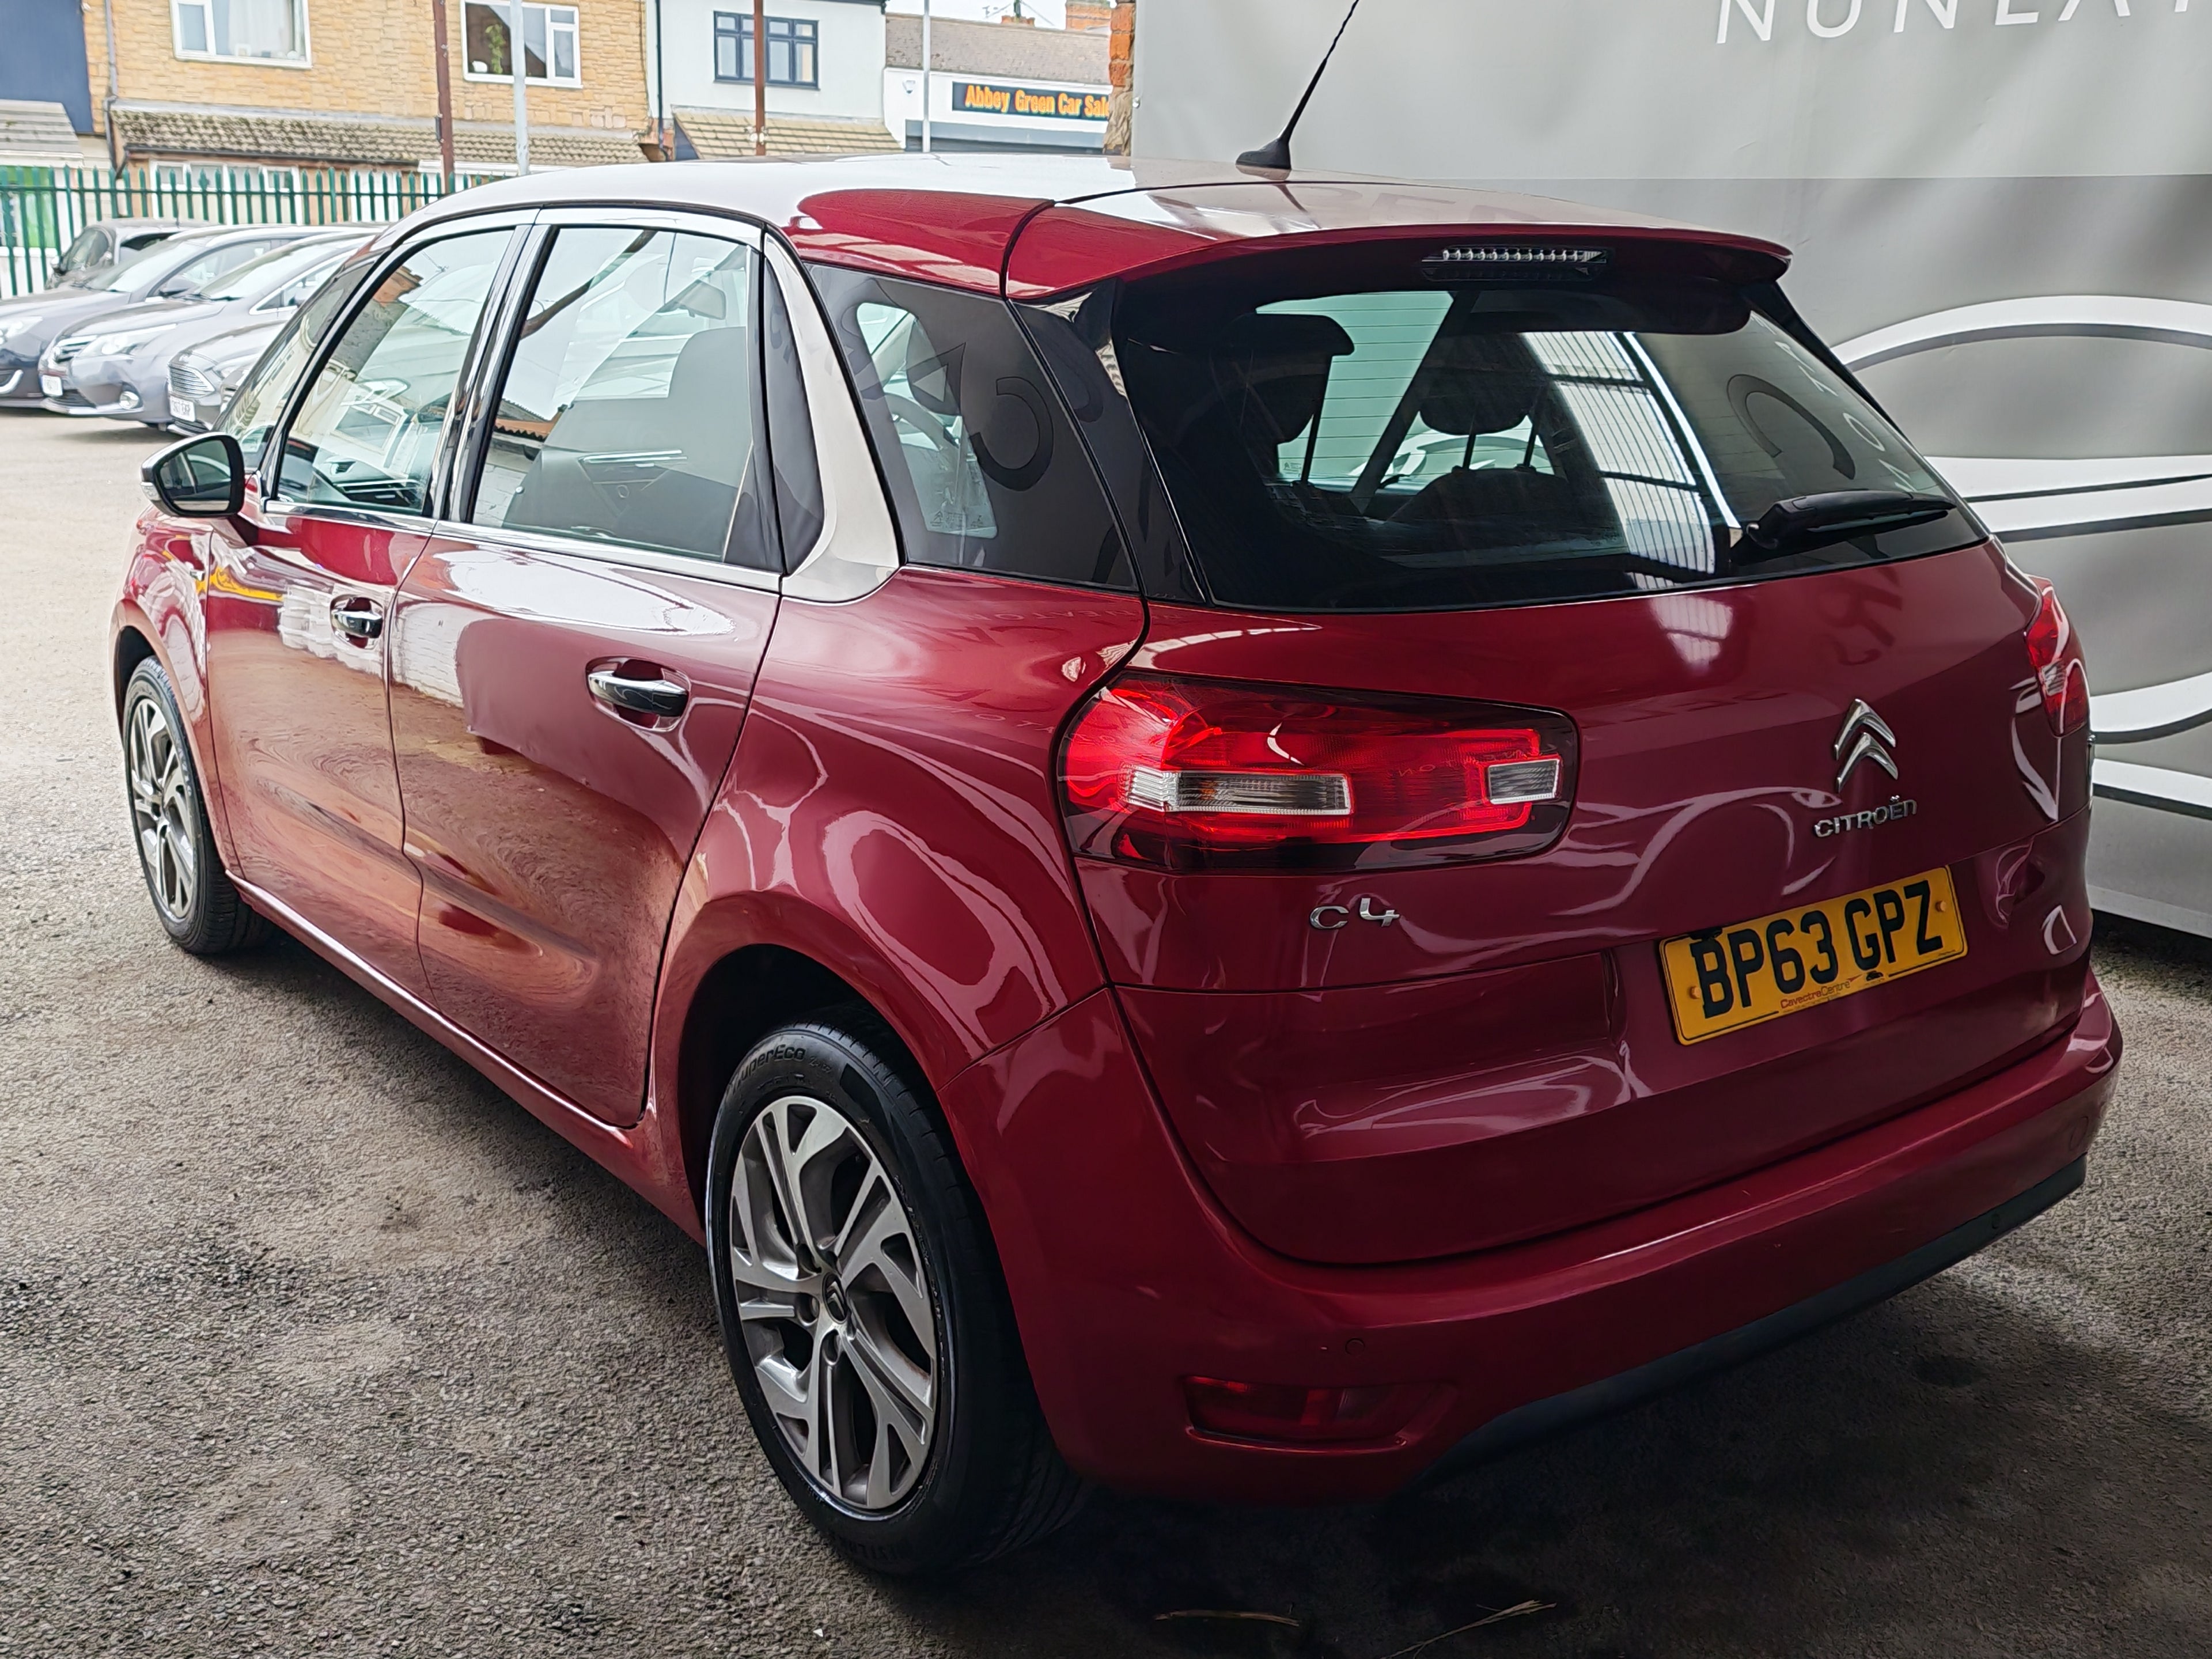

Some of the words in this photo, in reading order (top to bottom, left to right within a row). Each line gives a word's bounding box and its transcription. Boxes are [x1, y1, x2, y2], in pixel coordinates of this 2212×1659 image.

[964, 85, 1010, 113] Abbey
[1014, 89, 1055, 115] Green
[1058, 93, 1083, 116] Car
[1309, 897, 1400, 930] C4
[1689, 910, 1839, 1019] BP63
[1844, 880, 1944, 971] GPZ
